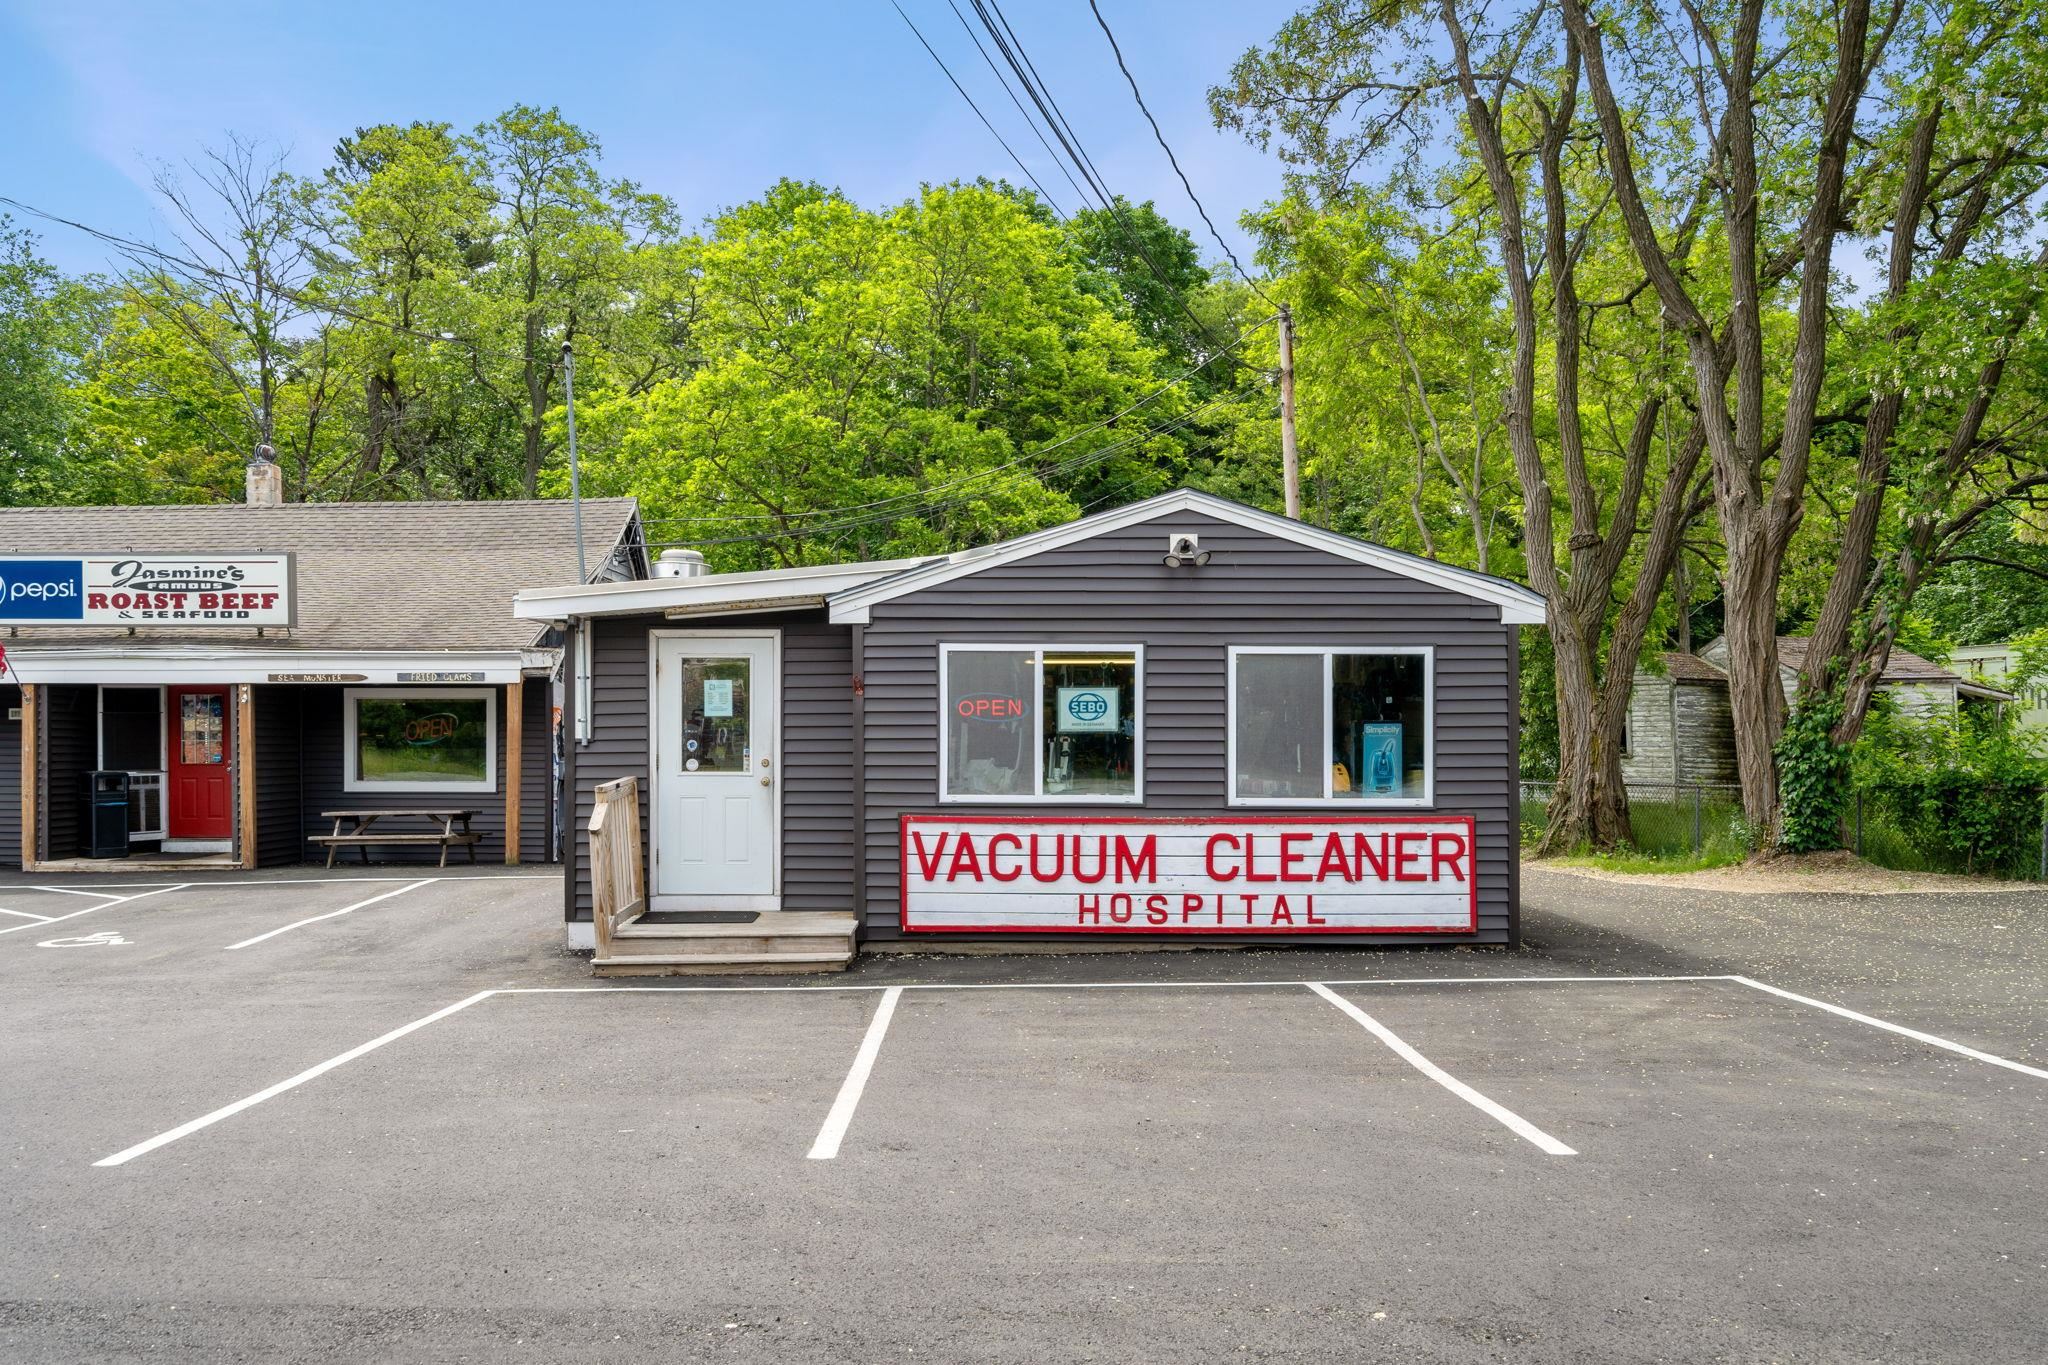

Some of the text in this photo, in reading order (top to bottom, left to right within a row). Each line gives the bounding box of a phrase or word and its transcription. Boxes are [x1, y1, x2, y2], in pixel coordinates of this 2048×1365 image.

[111, 560, 245, 587] Jasmine's
[11, 579, 74, 601] pepsi
[147, 582, 223, 590] FAMOUS
[88, 593, 279, 609] ROAST BEEF
[118, 610, 249, 619] & SEAFOOD
[411, 673, 472, 682] FRIED CLAMS
[959, 699, 1023, 717] OPEN
[1071, 702, 1105, 712] SEBO
[405, 718, 453, 740] OPEN
[1366, 725, 1400, 735] Simplicity
[912, 831, 1466, 884] VACUUM CLEANER
[1078, 893, 1326, 925] HOSPITAL
